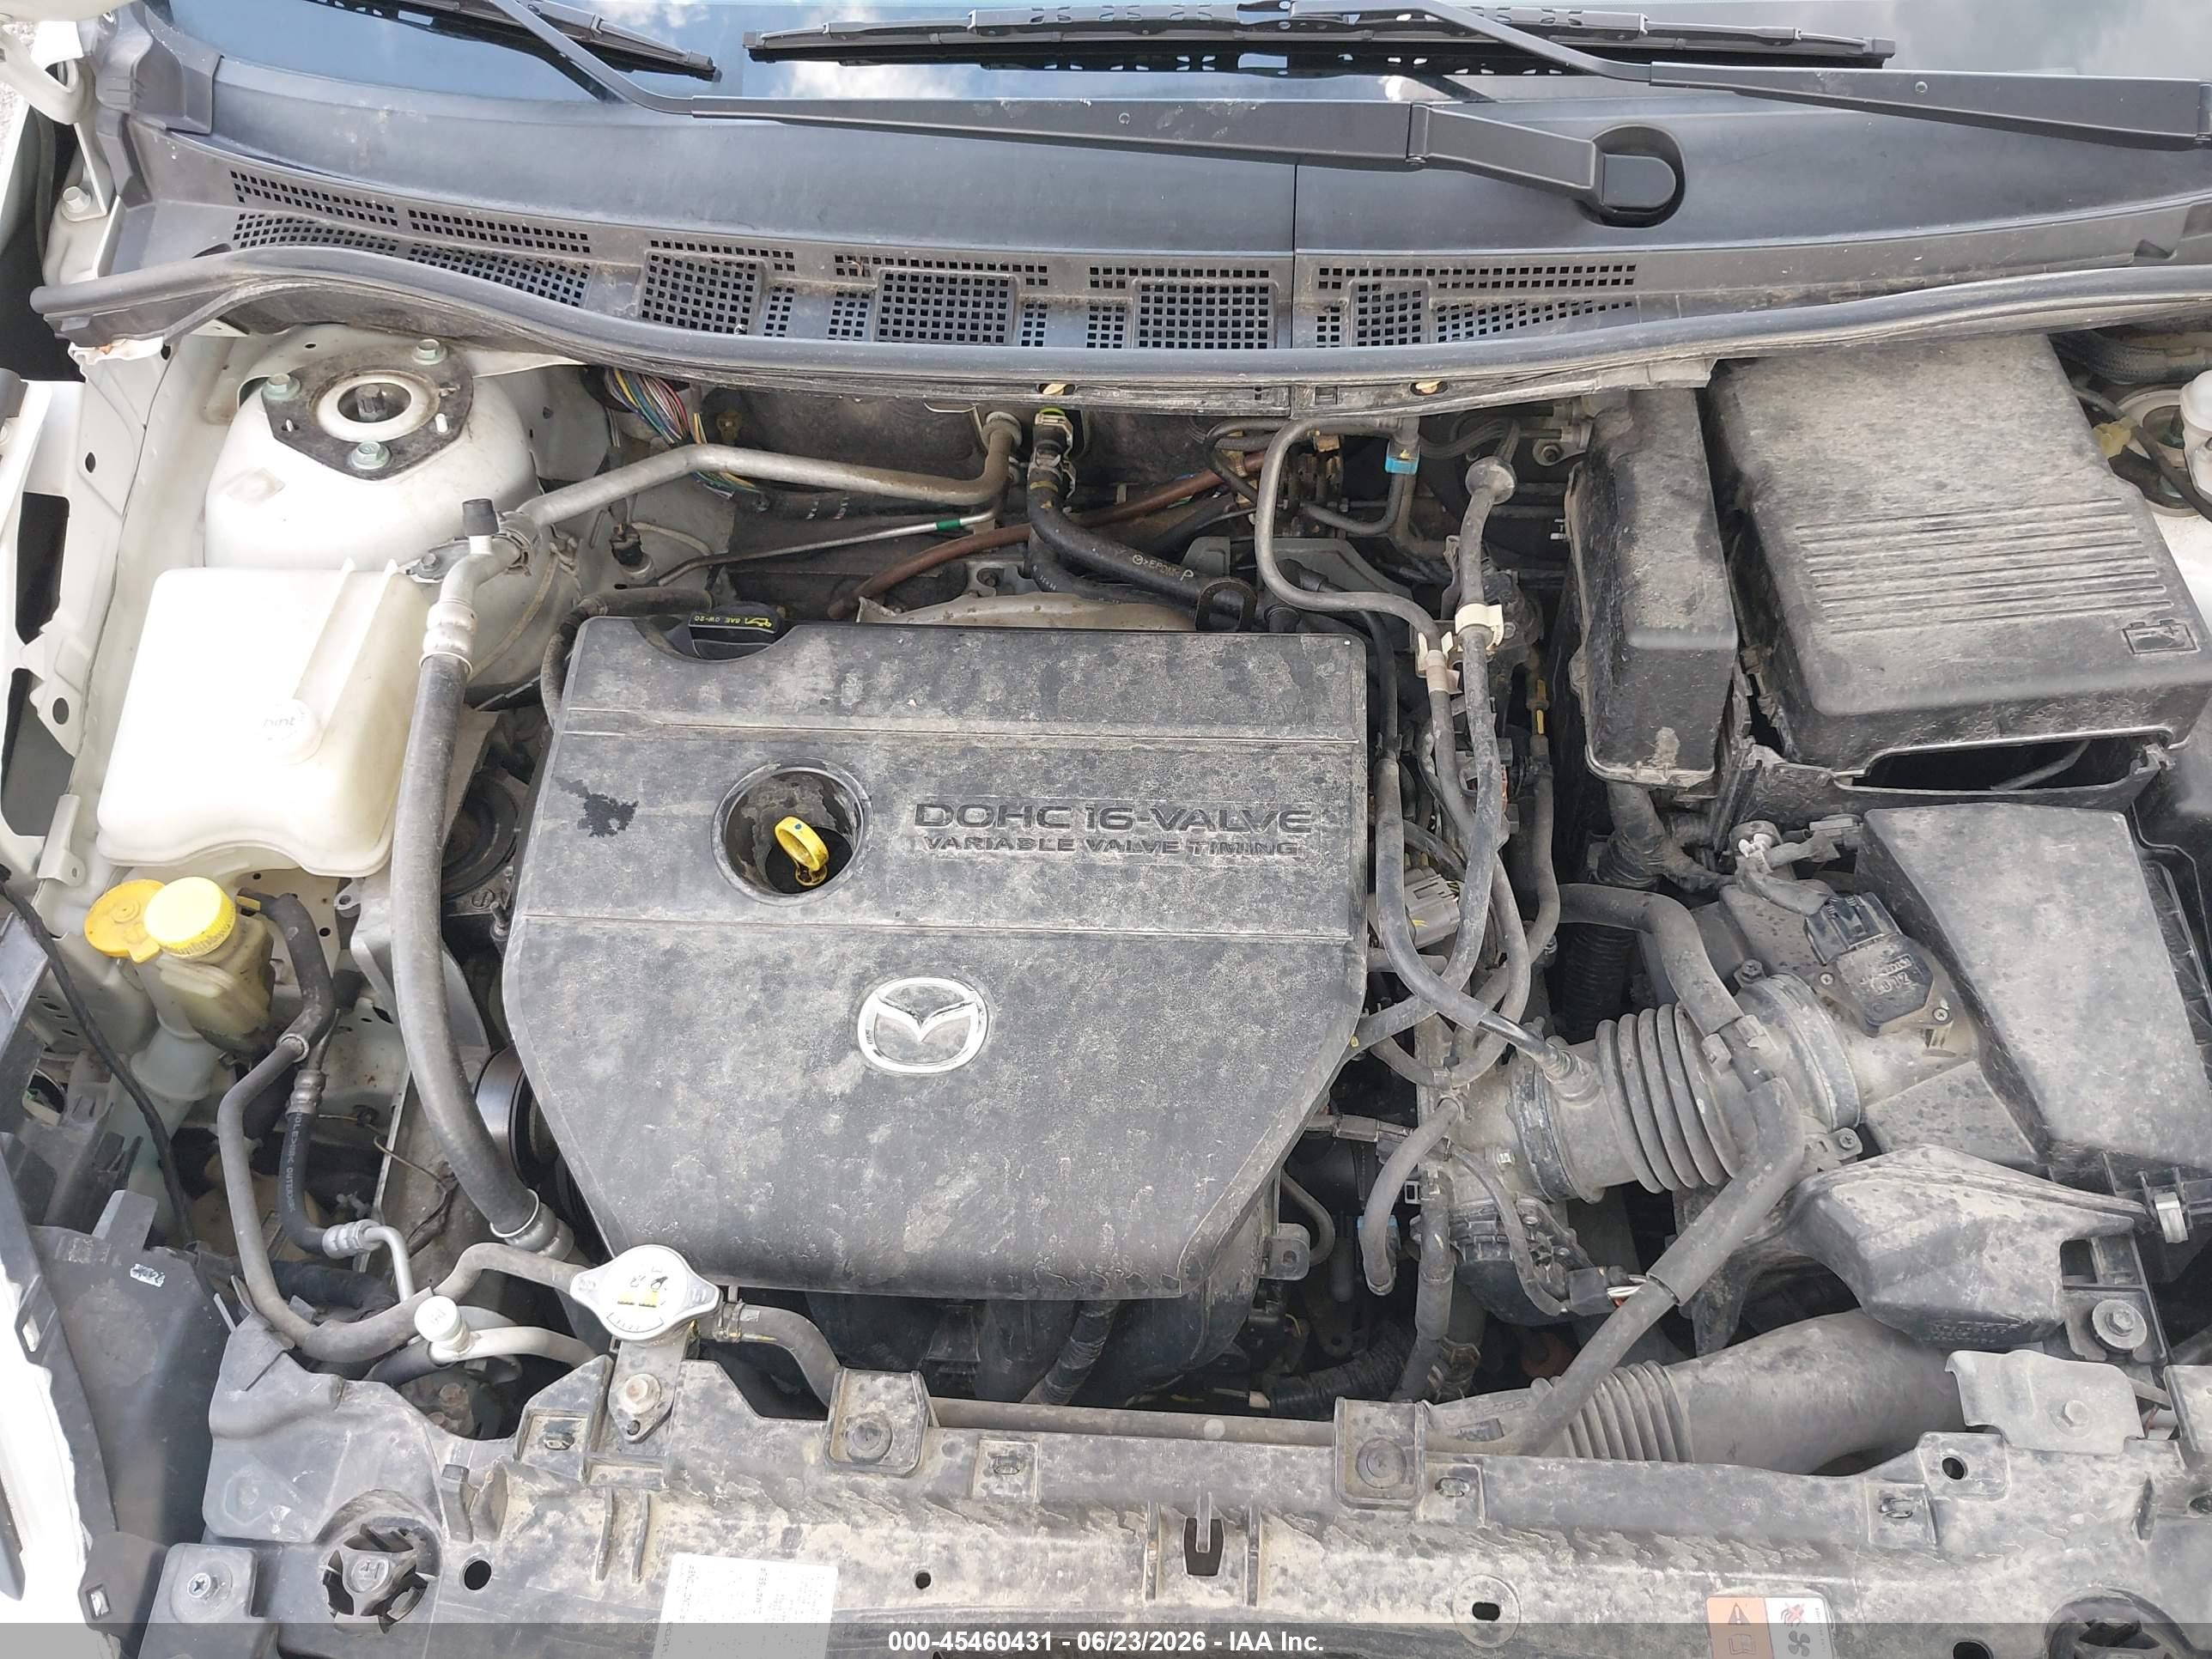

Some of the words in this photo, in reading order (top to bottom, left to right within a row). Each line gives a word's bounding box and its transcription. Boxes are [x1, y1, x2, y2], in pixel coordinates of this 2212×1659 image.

[914, 803, 1074, 830] DOHC
[1083, 802, 1313, 834] 16-VALVE
[922, 835, 1076, 853] VARIABLE
[1084, 838, 1182, 855] VALVE
[1188, 840, 1300, 858] TIMING
